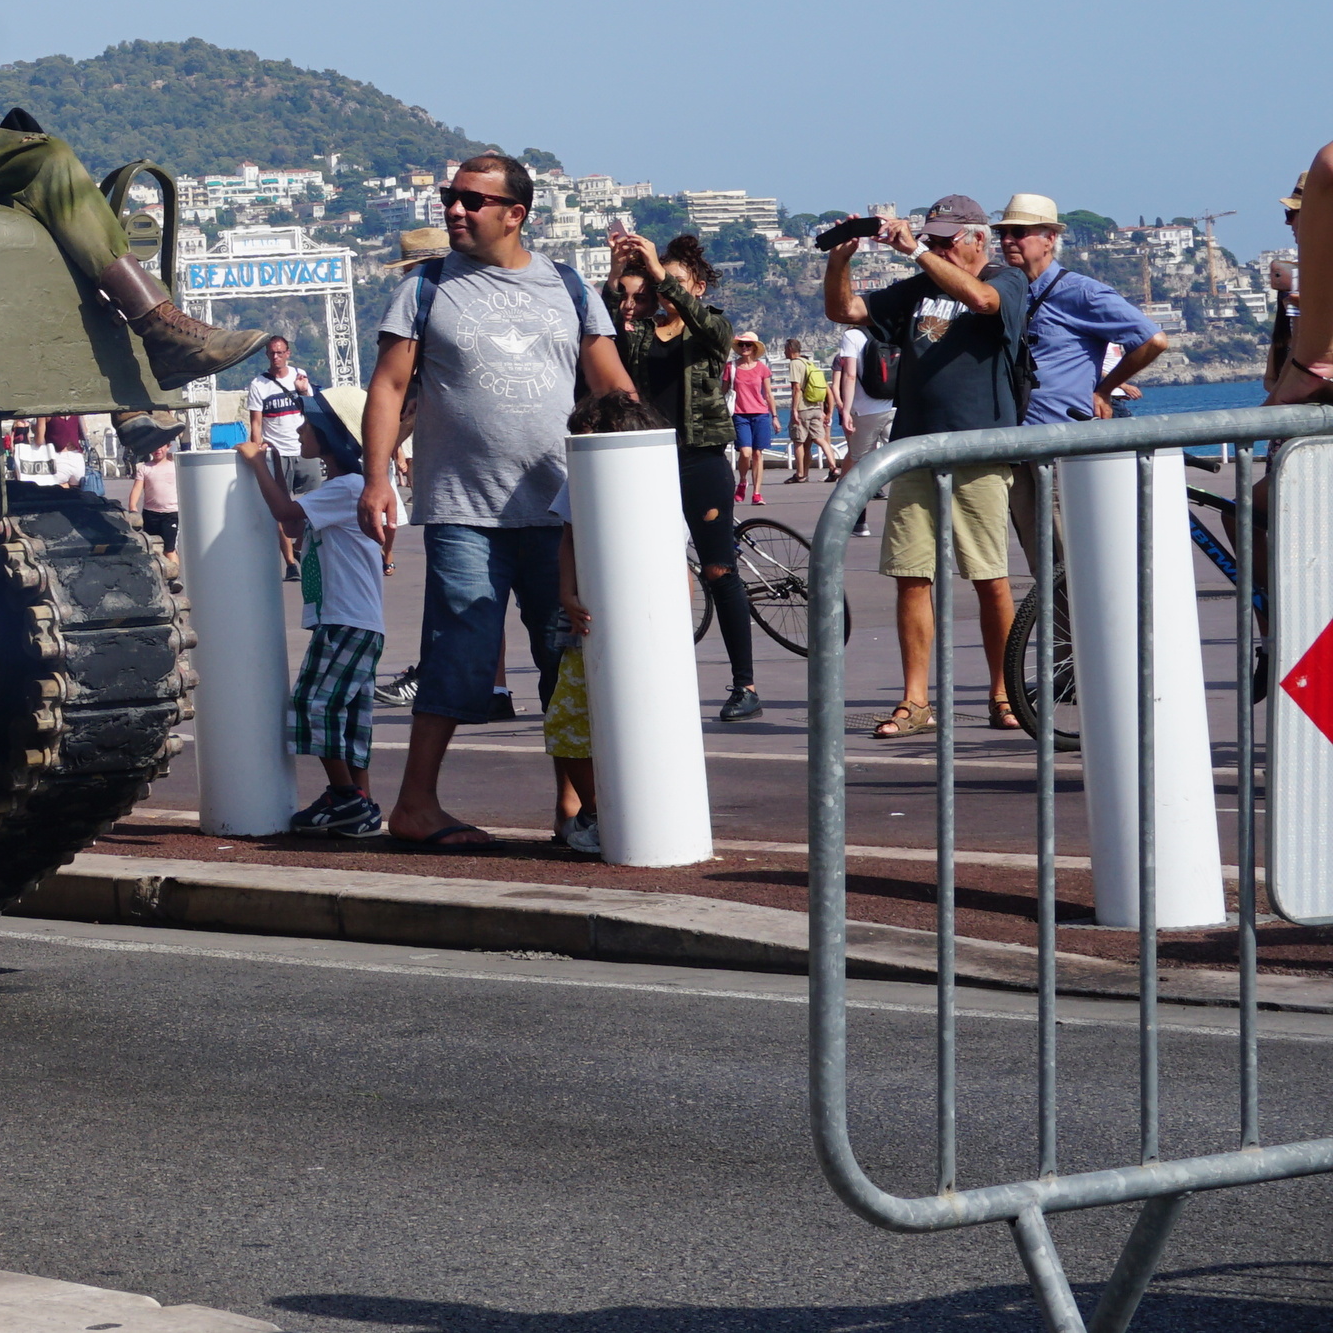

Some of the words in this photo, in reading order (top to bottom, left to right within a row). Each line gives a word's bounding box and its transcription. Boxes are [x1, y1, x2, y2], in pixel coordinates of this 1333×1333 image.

[189, 262, 255, 289] BEAU
[259, 258, 343, 286] RIVAGE
[477, 290, 533, 312] YOUR
[456, 300, 481, 351] GET
[468, 357, 559, 399] TOGETHER
